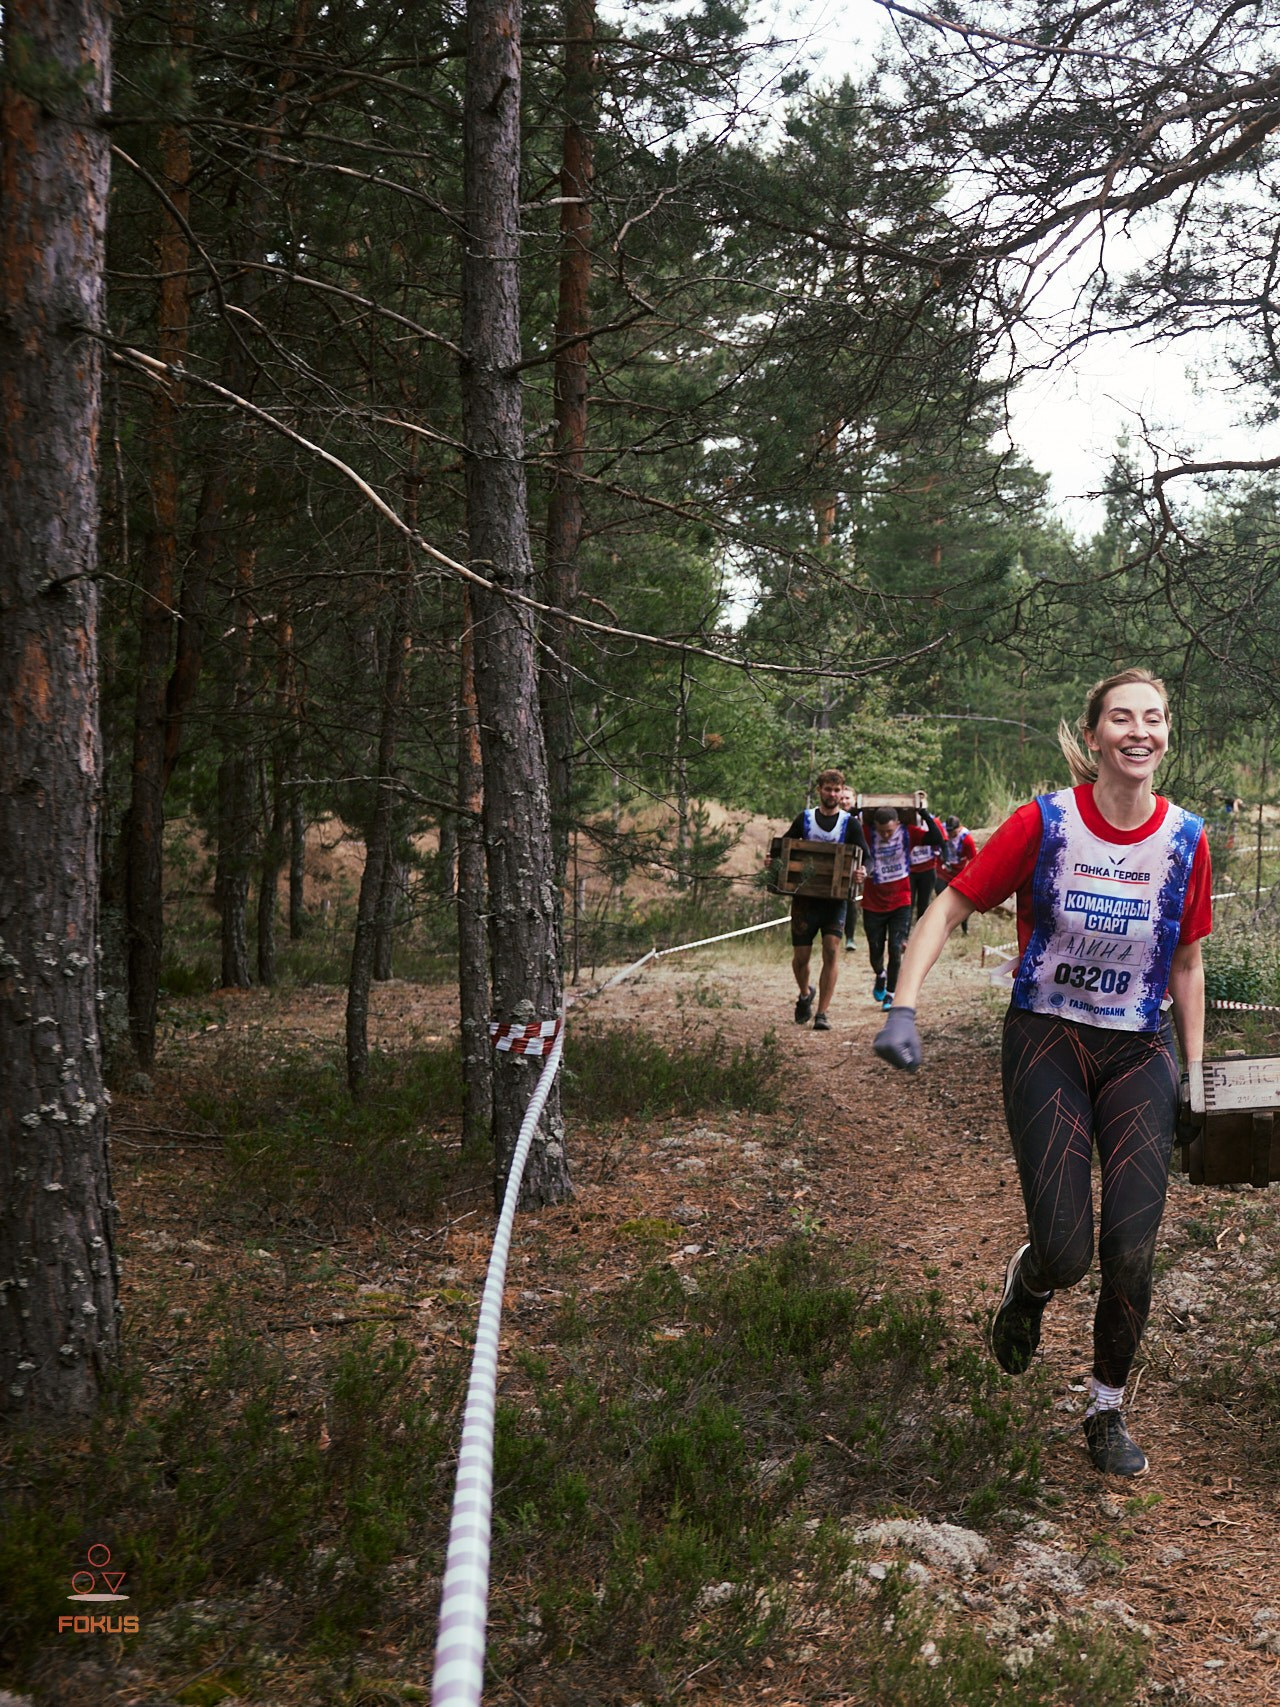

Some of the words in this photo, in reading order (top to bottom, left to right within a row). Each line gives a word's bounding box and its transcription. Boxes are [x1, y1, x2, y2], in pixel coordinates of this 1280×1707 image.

[1074, 863, 1110, 877] ГОНКА
[1114, 869, 1150, 882] ГЕРОЕВ
[1066, 893, 1150, 918] КОМАНДНЫЙ
[1087, 914, 1127, 934] СТАРТ
[1065, 936, 1135, 962] АЛИНА
[1054, 962, 1131, 994] 03208
[1069, 998, 1126, 1017] ГАЗПРОМБАНК
